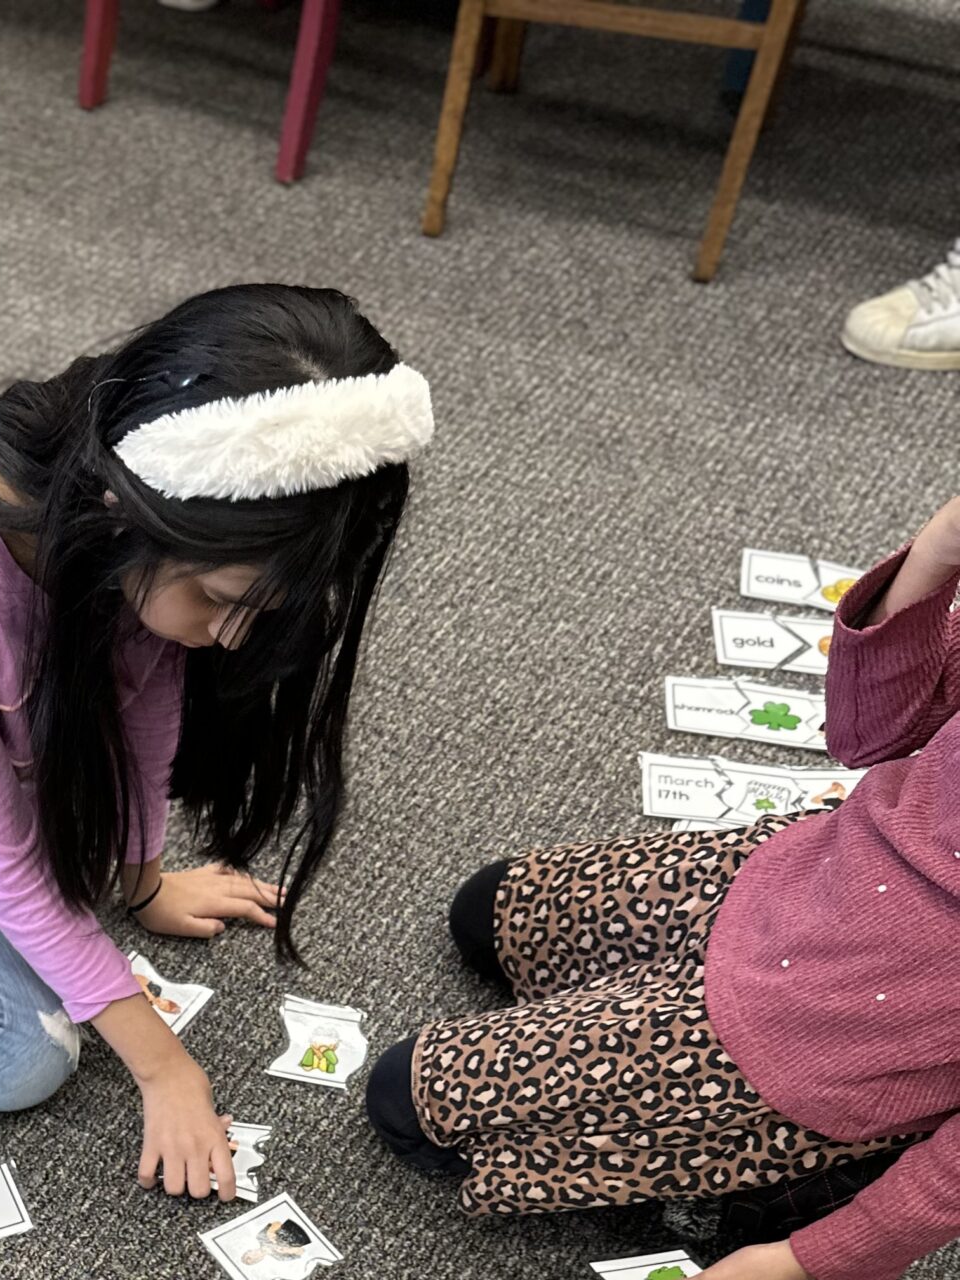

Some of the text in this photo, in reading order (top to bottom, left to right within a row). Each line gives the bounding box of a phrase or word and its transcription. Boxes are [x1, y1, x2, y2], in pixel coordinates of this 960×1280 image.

[755, 573, 802, 588] coins
[732, 635, 775, 650] gold
[658, 774, 715, 789] March
[658, 789, 690, 801] 17th
